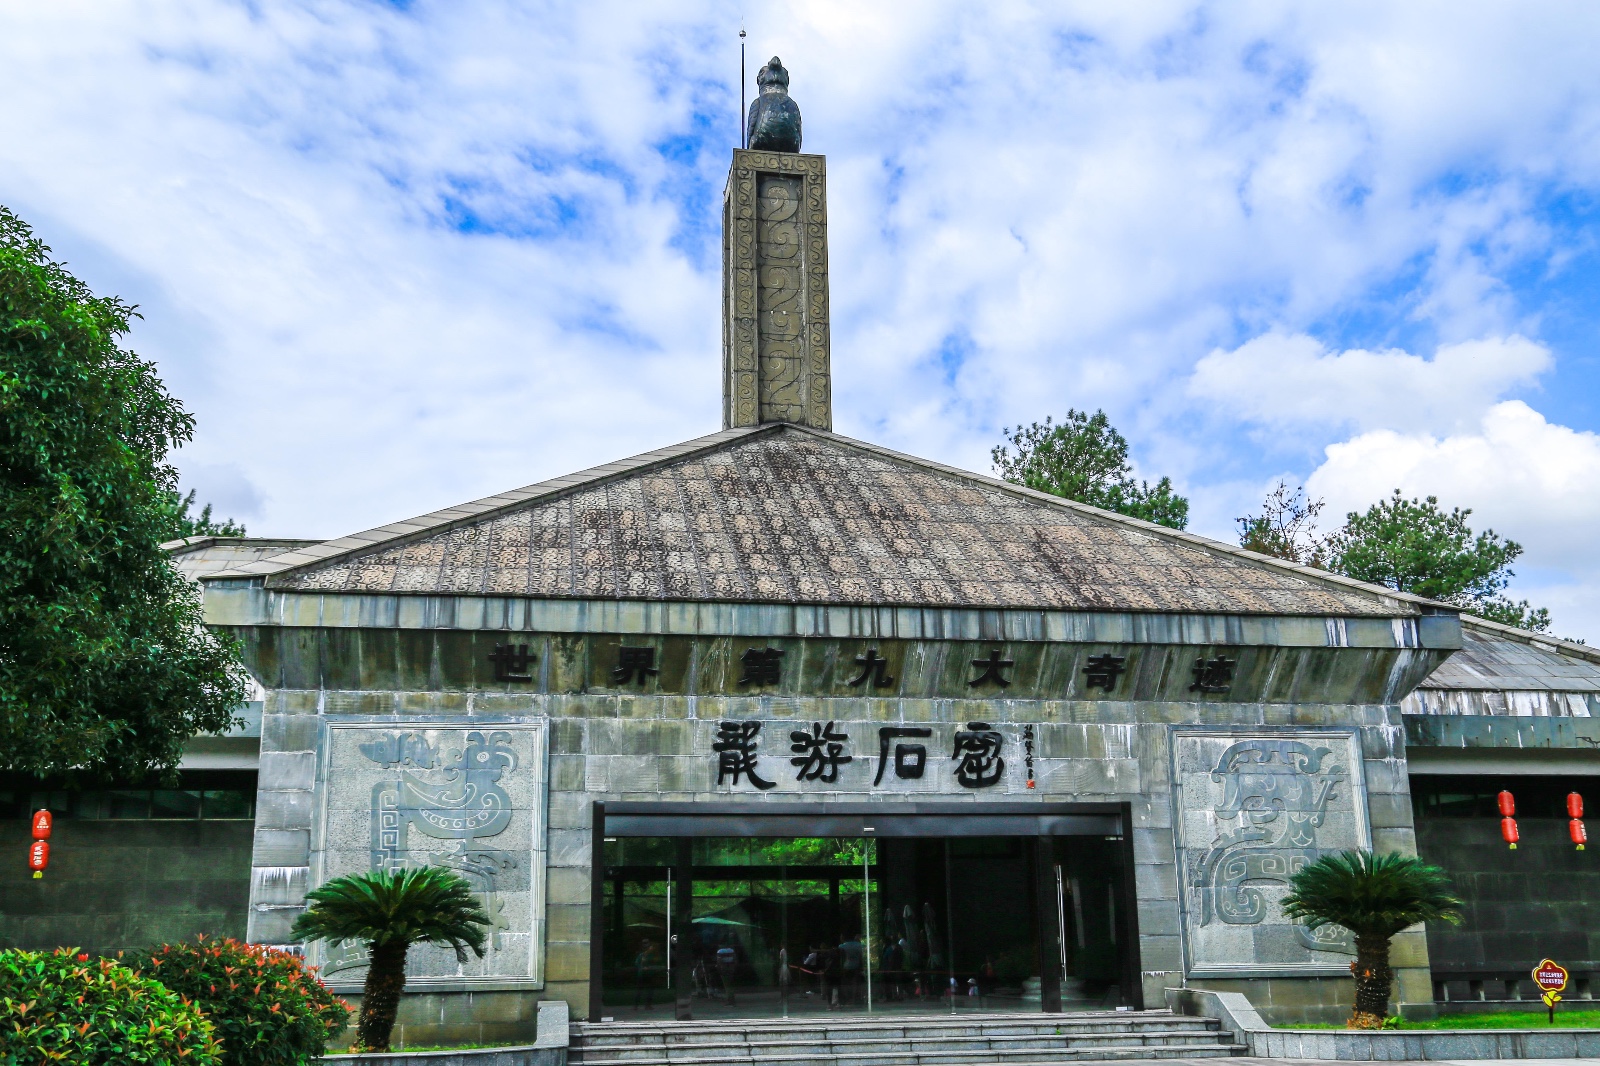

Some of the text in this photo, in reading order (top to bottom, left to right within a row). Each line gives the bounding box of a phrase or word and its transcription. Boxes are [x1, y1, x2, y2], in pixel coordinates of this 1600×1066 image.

[488, 643, 1236, 694] 世界第九大奇迹
